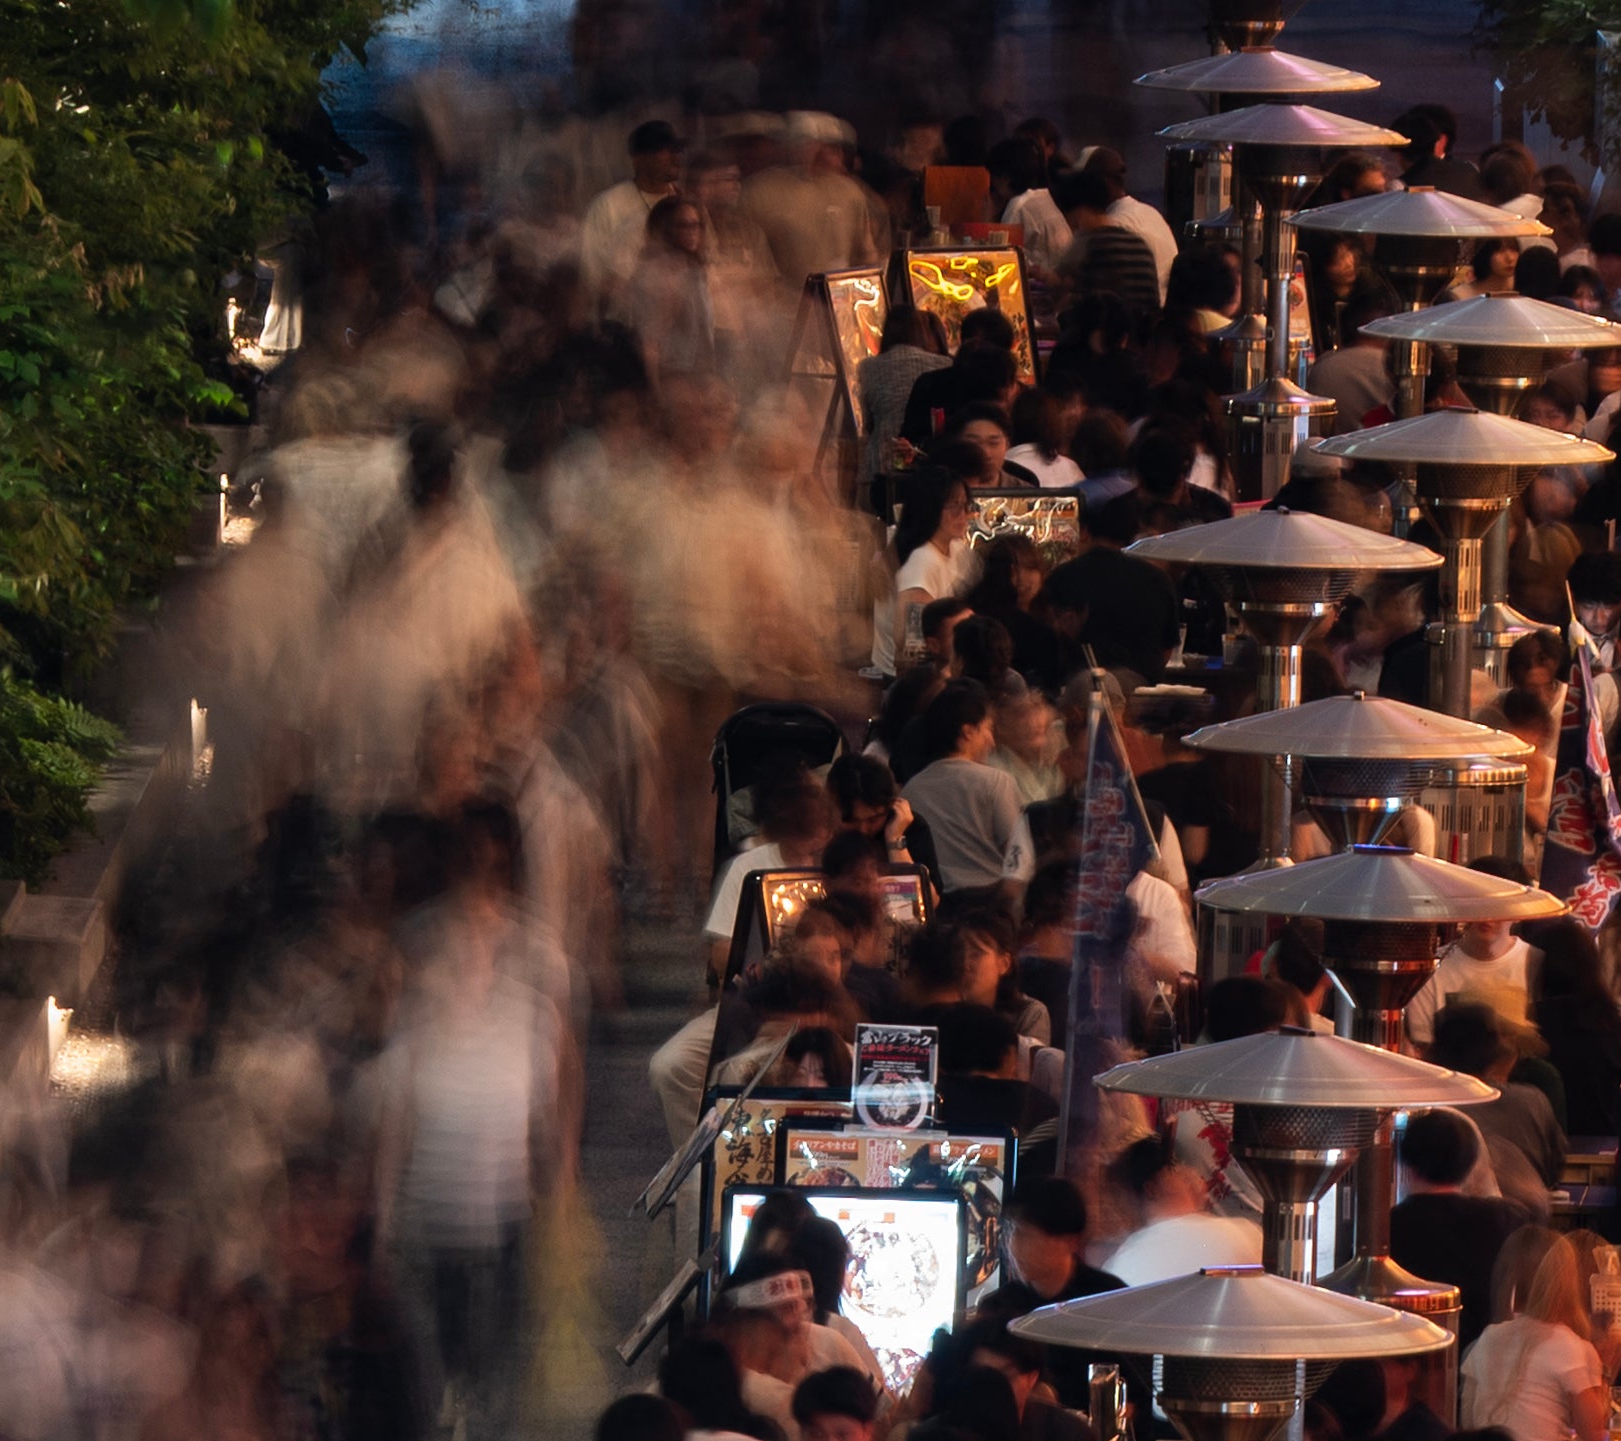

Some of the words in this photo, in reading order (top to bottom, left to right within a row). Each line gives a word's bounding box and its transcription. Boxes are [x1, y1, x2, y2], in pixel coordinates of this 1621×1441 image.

[793, 1139, 857, 1151] イリアンやきそば
